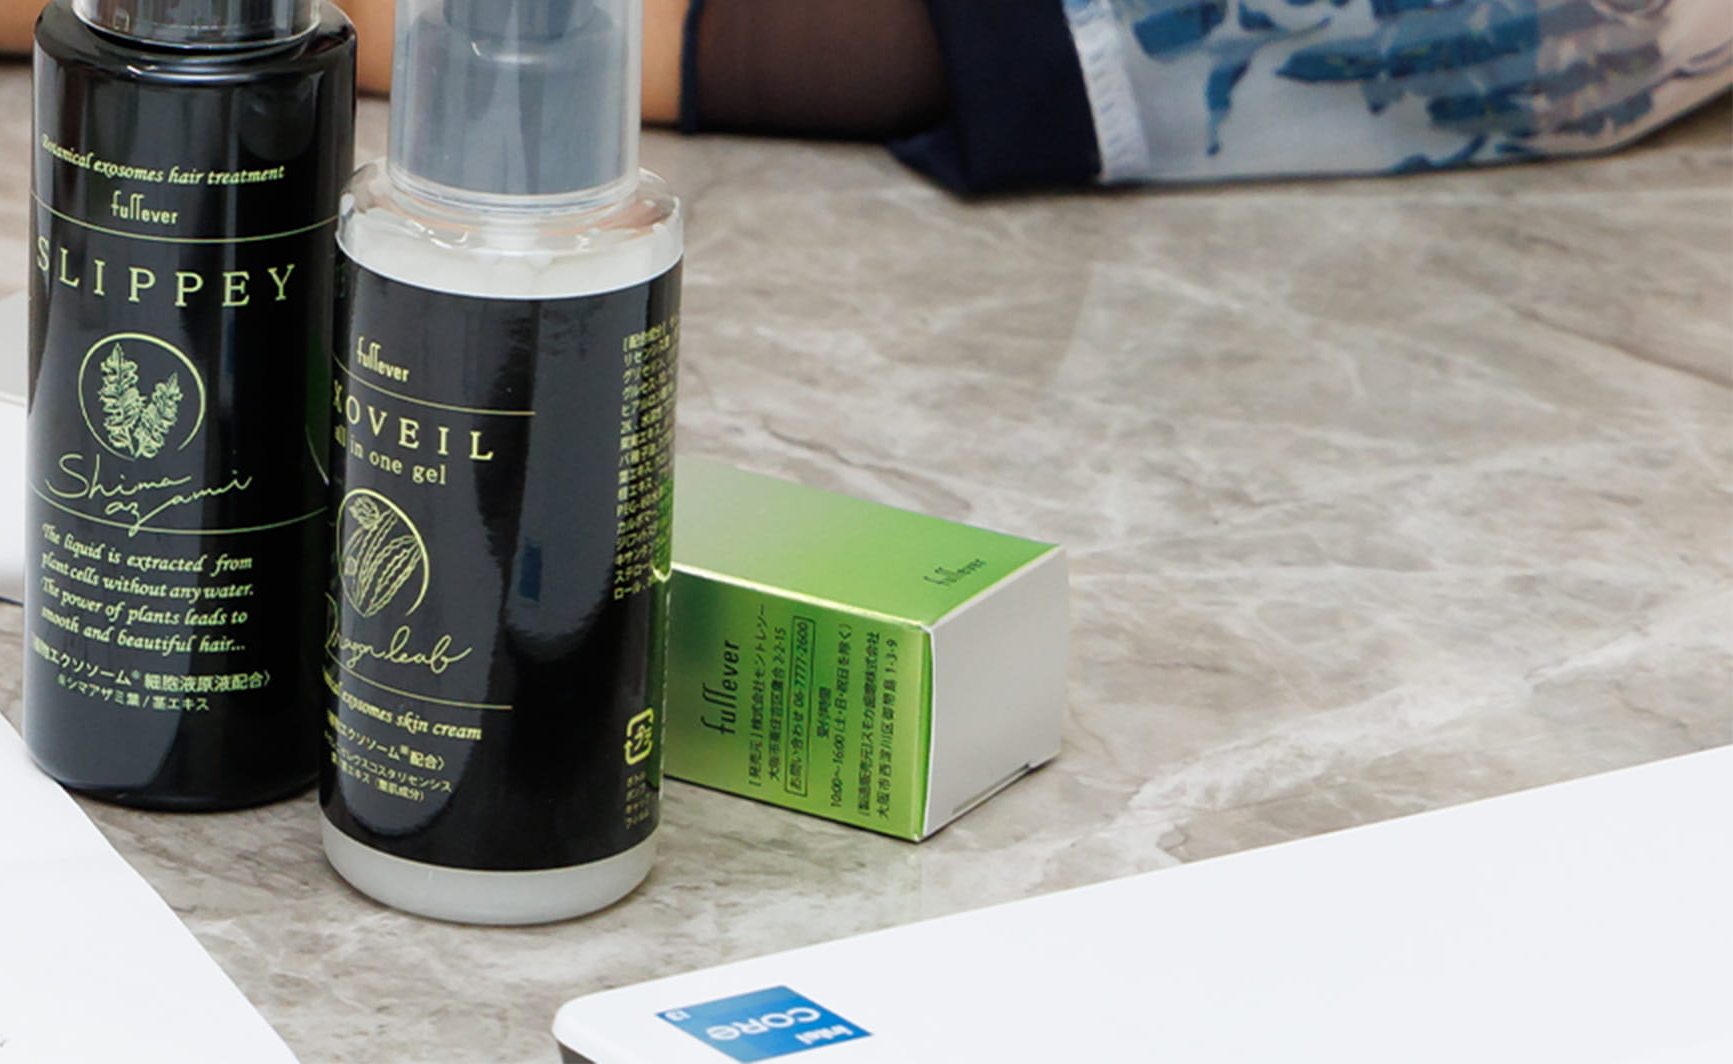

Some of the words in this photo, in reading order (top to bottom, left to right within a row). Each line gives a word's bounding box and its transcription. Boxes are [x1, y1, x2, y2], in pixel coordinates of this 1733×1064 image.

[94, 158, 164, 184] exosomes
[168, 165, 204, 185] hair
[207, 164, 286, 185] treatment
[111, 190, 179, 226] fullever
[36, 236, 296, 307] SLIPPEY
[357, 336, 410, 382] fullever
[45, 453, 192, 499] Shima
[350, 434, 364, 459] in
[369, 450, 403, 475] one
[412, 463, 447, 485] gel
[42, 523, 61, 545] The
[64, 532, 105, 560] liquid
[108, 547, 121, 564] is
[126, 554, 208, 572] extracted
[210, 553, 253, 577] from
[41, 552, 70, 575] plant
[70, 567, 100, 586] cells
[102, 575, 167, 597] without
[169, 586, 202, 604] any
[204, 583, 254, 598] water.
[42, 576, 60, 597] The
[61, 589, 103, 613] power
[105, 603, 125, 622] of
[126, 605, 180, 626] plants
[184, 608, 228, 626] leads
[231, 610, 248, 624] to
[84, 625, 115, 643] and
[117, 629, 194, 657] beautiful
[701, 639, 742, 736] fullever
[341, 691, 393, 724] exosomes
[397, 711, 429, 735] skin
[432, 723, 482, 741] cream
